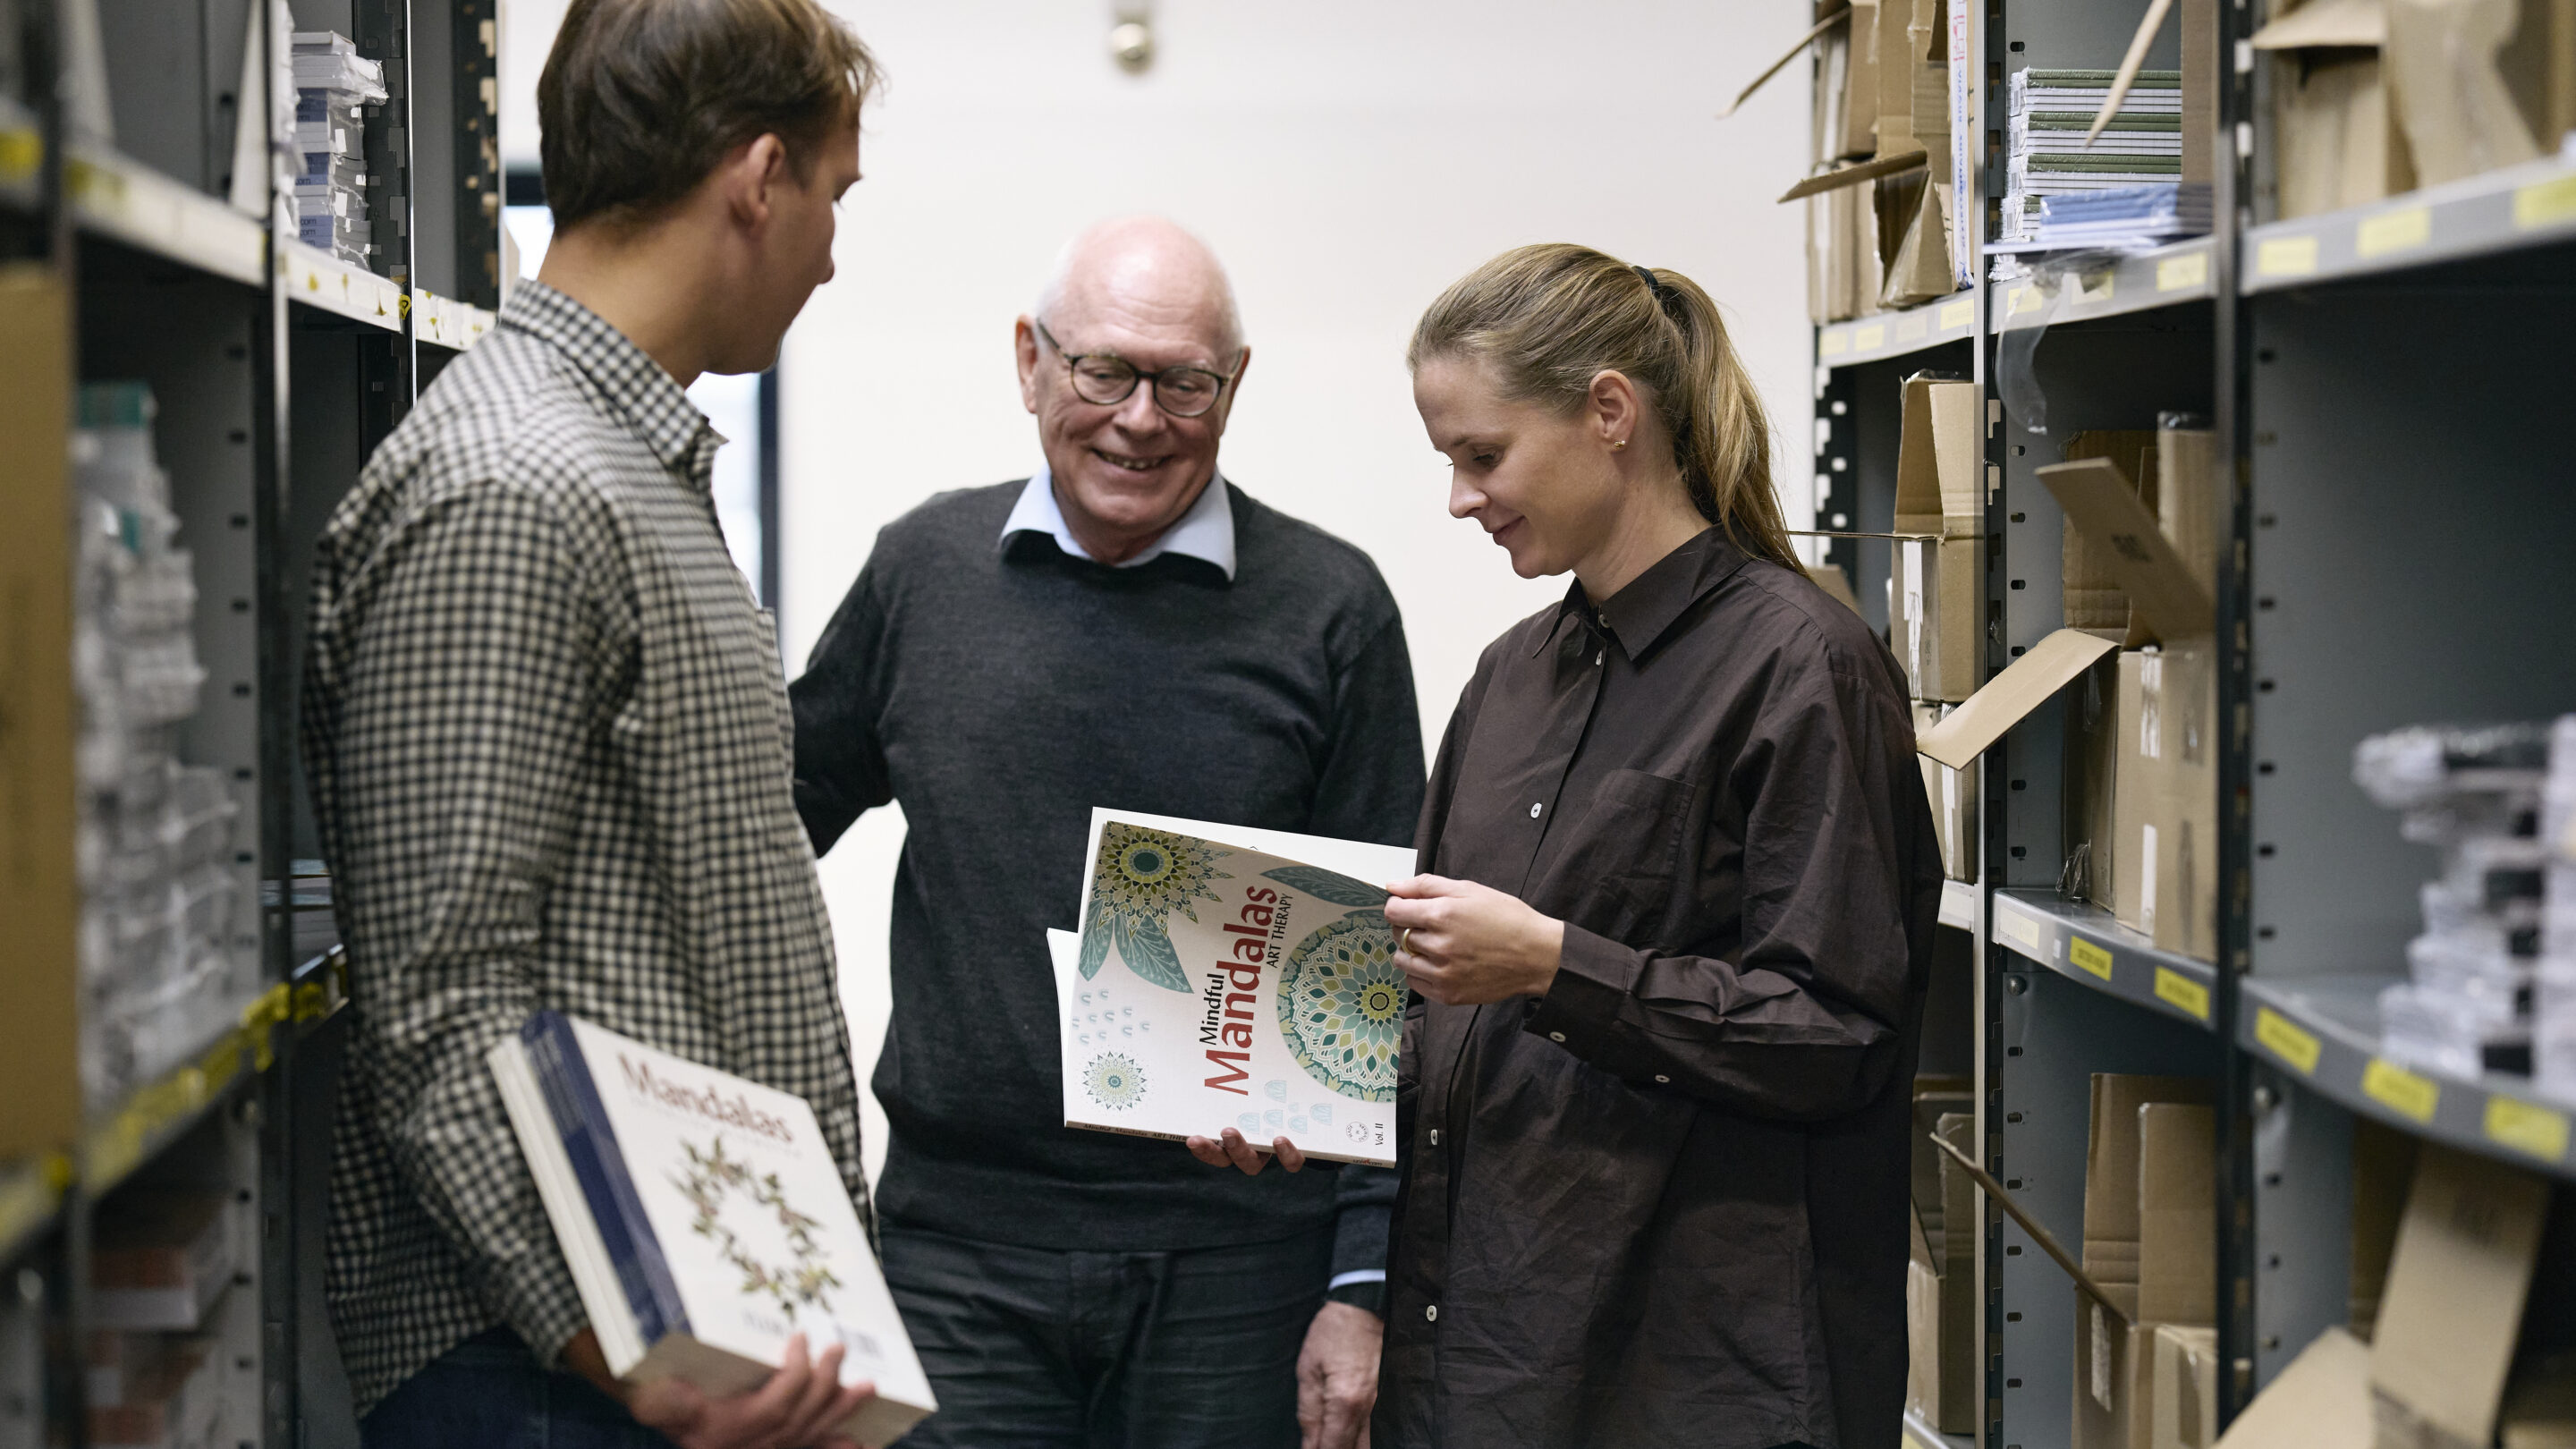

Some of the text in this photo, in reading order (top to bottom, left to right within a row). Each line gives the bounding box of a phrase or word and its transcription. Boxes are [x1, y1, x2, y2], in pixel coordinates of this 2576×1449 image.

[1267, 894, 1293, 969] ART THERAPY
[1199, 973, 1224, 1046] Mindful
[1204, 886, 1277, 1096] Mandalas
[619, 1053, 793, 1143] Mandalas
[1169, 1134, 1188, 1142] THER
